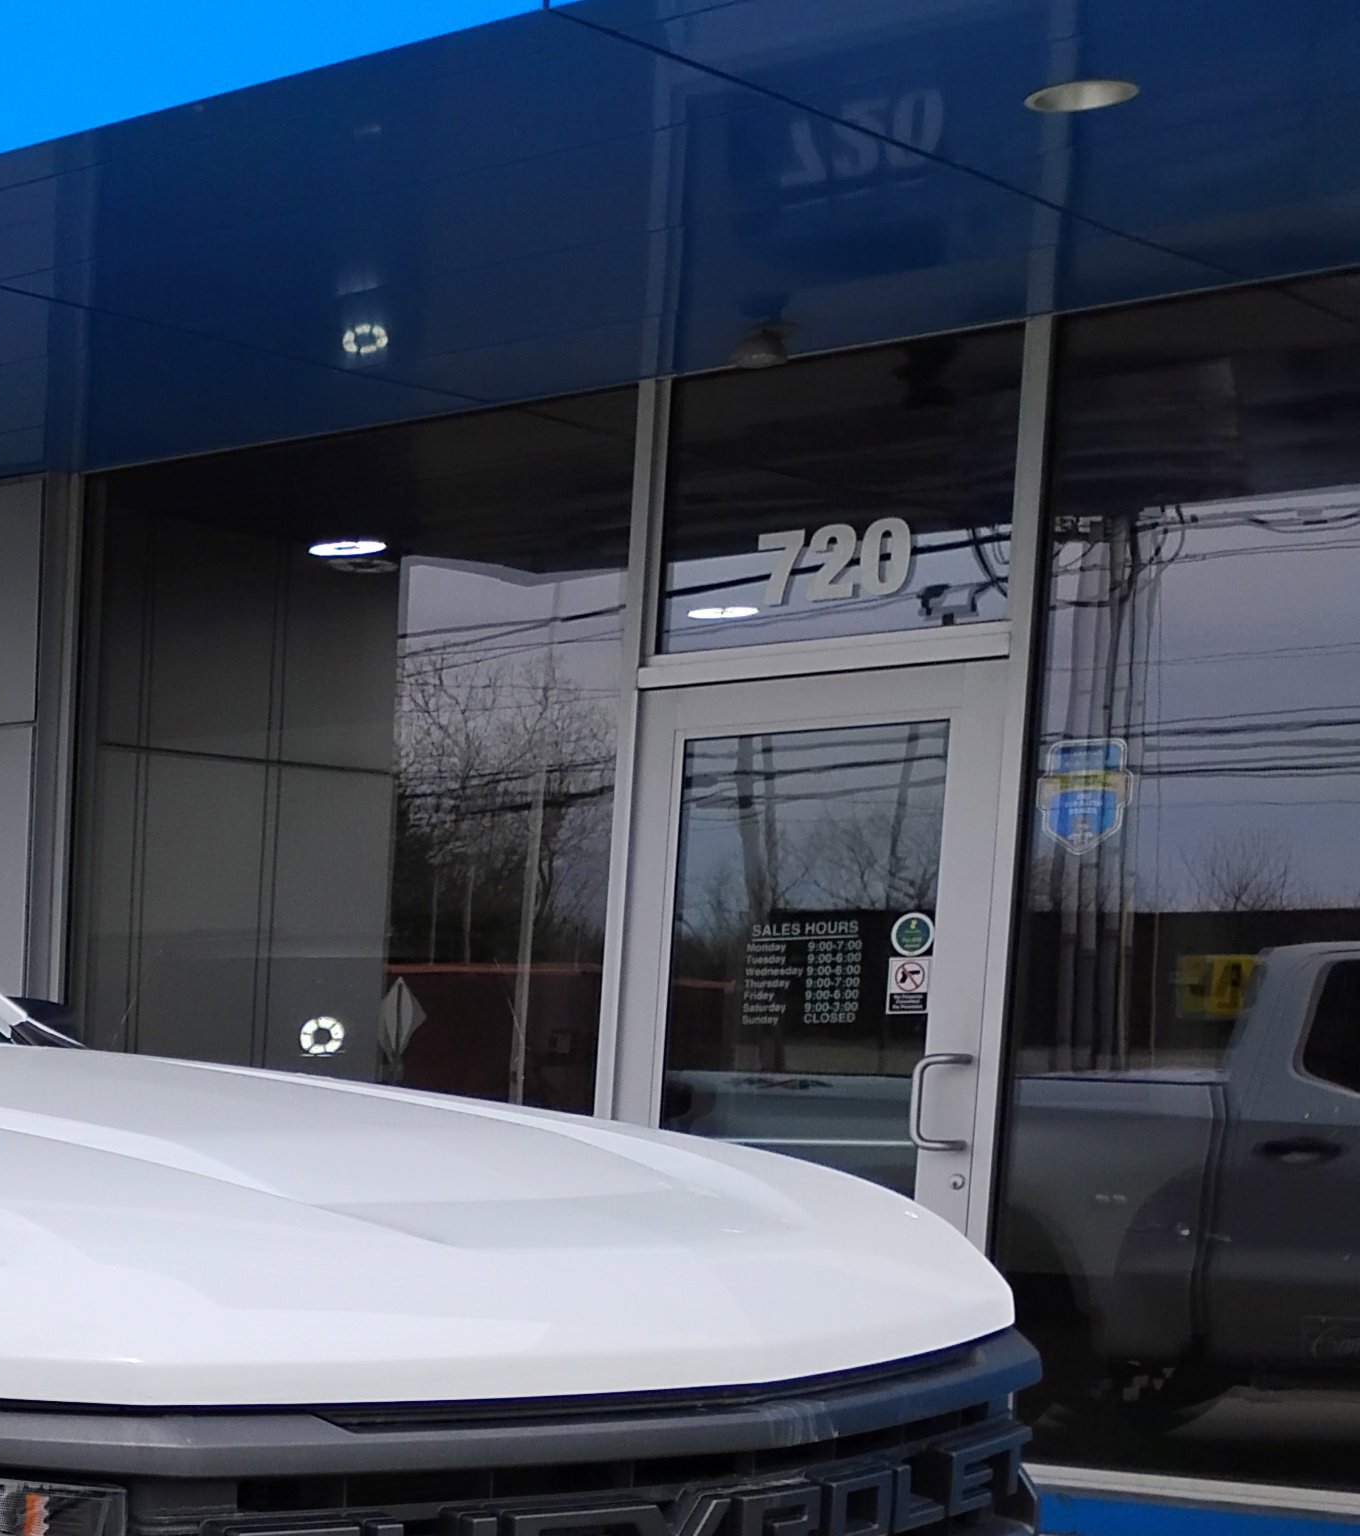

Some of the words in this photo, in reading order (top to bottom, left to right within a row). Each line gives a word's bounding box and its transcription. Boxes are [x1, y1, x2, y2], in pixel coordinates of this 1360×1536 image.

[758, 516, 912, 607] 720
[752, 923, 801, 937] SALES
[805, 920, 859, 935] HOURS
[746, 943, 787, 953] Monday
[807, 940, 863, 951] 9:00-7:00
[746, 955, 786, 965] Tuesday
[807, 953, 862, 963] 9:00-6:00
[745, 967, 803, 977] Wednesday
[806, 965, 861, 976] 9:00-6:00
[744, 979, 790, 989] Thursday
[805, 978, 860, 988] 9:00-7:00
[743, 991, 775, 1002] Friday
[805, 990, 859, 1000] 9:00-6:00
[743, 1004, 786, 1014] Saturday
[804, 1002, 859, 1012] 9:00-3:00
[742, 1016, 780, 1026] Sunday
[803, 1013, 856, 1024] CLOSED
